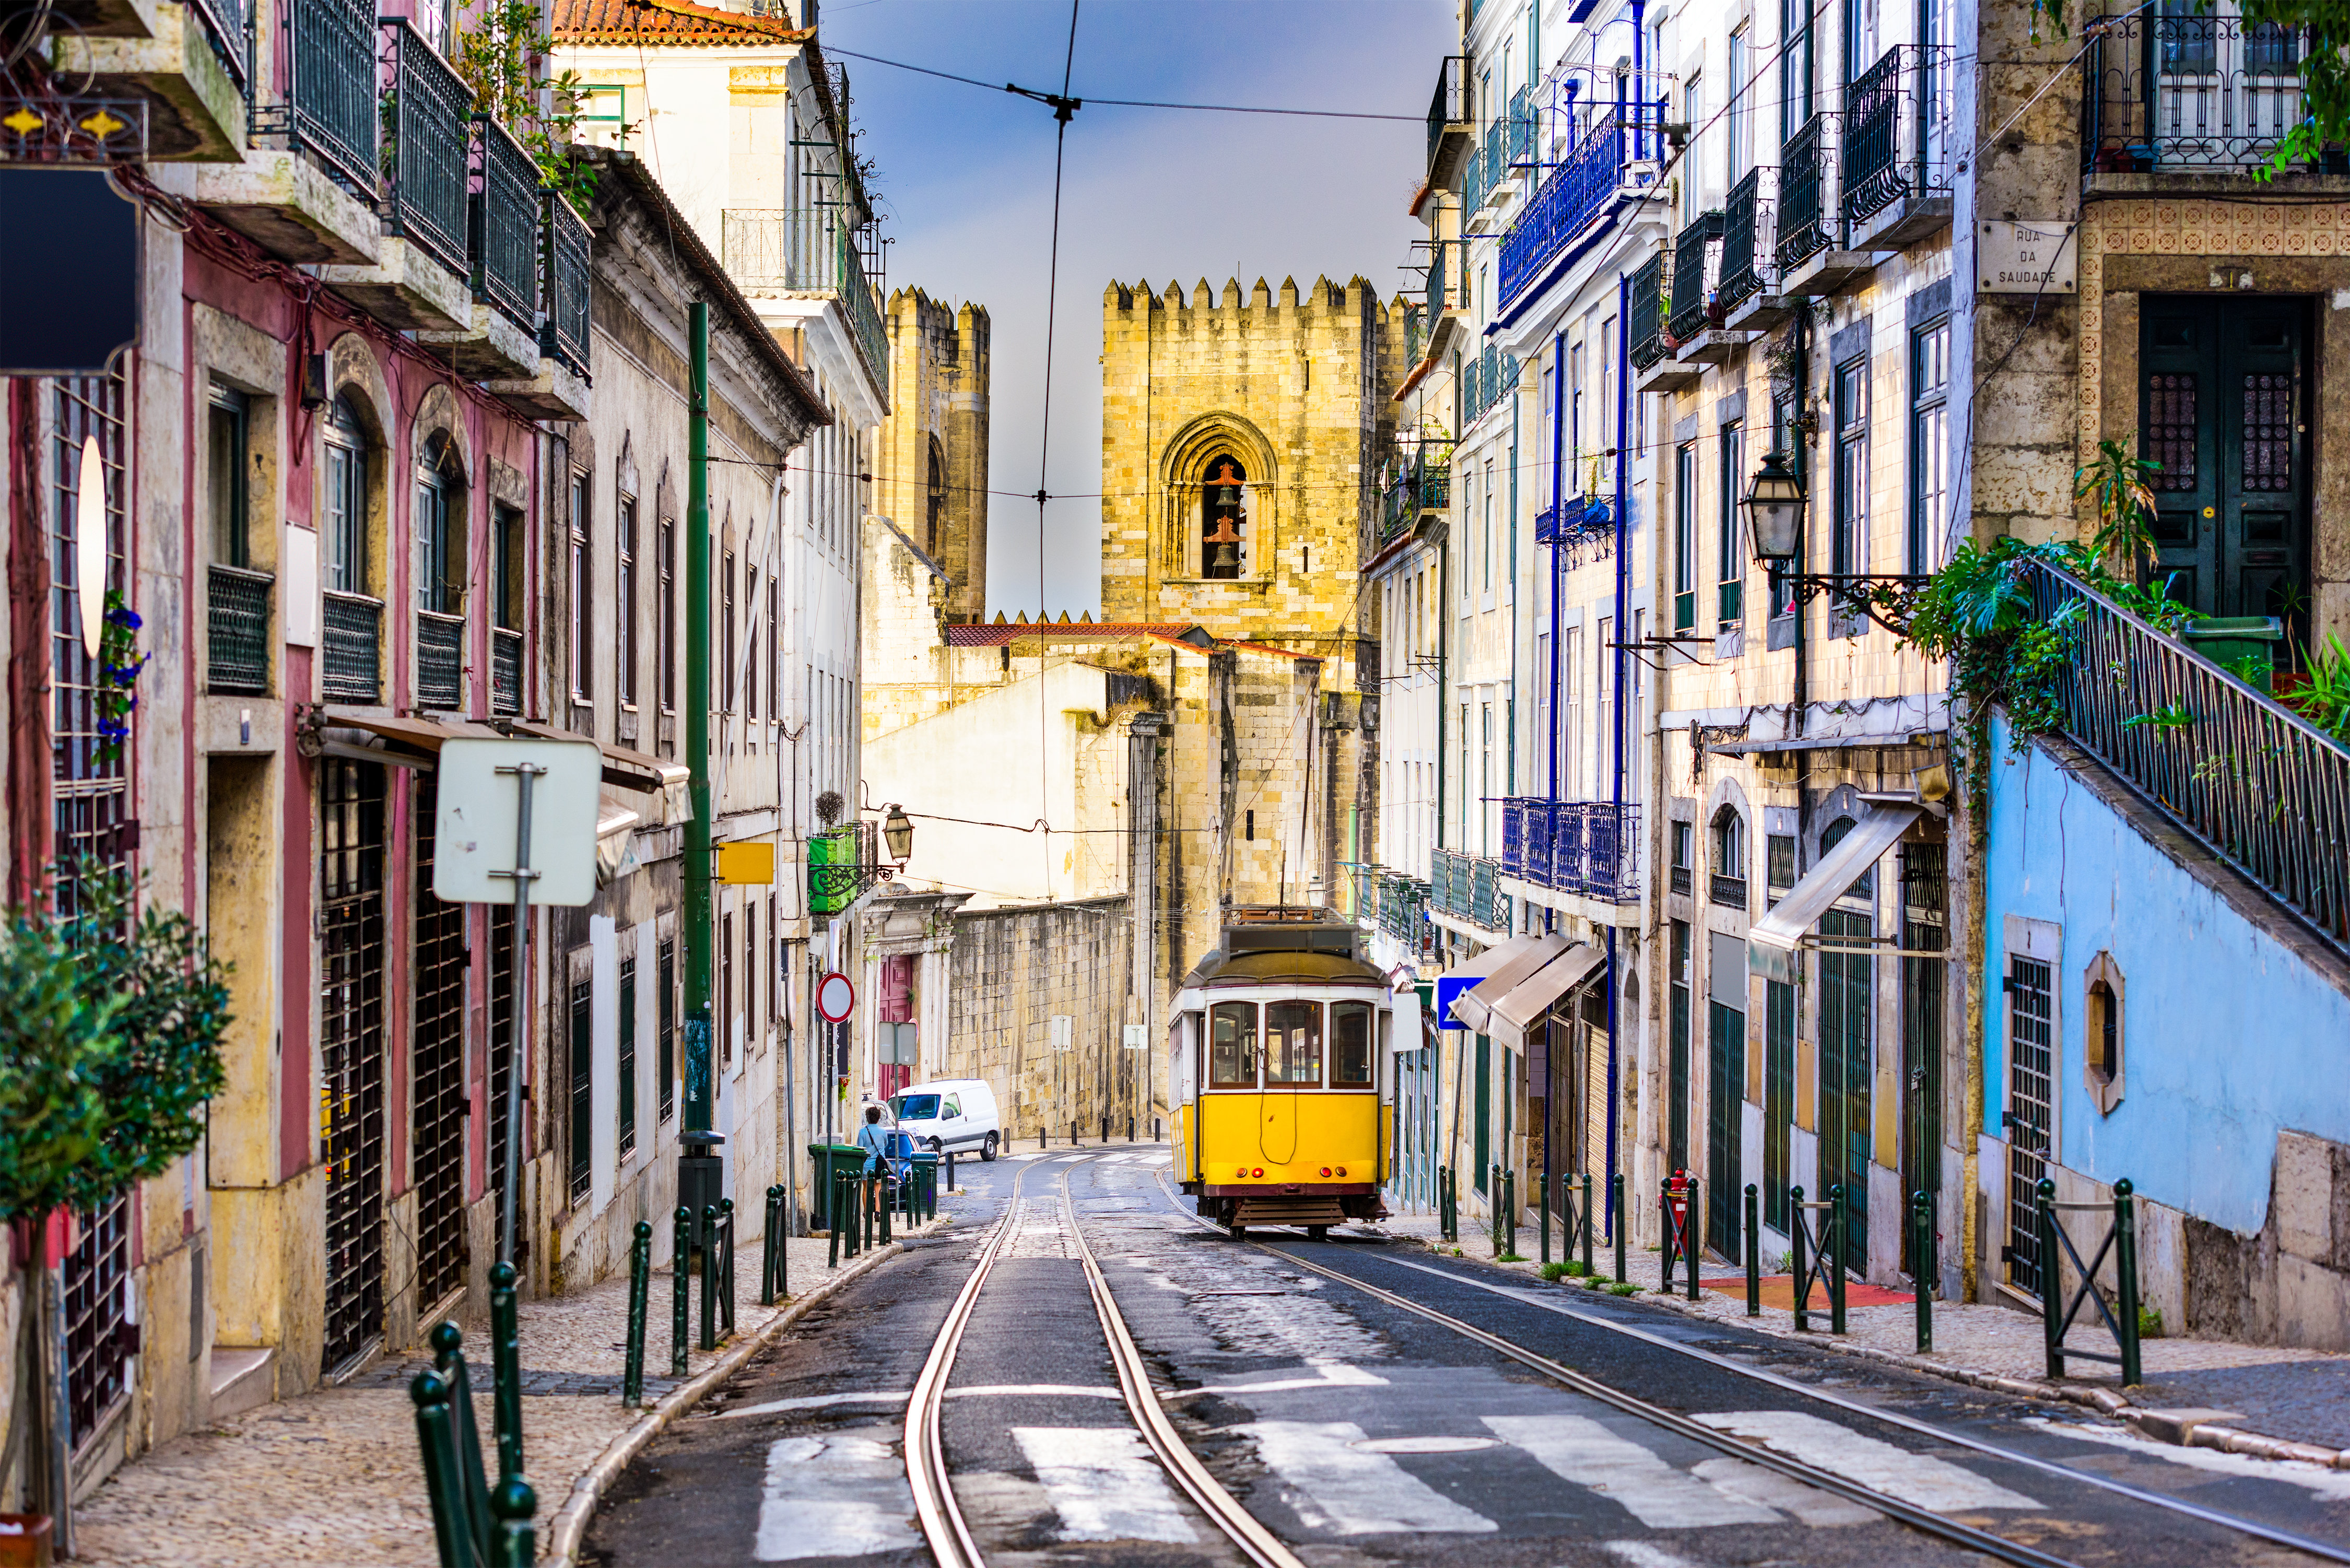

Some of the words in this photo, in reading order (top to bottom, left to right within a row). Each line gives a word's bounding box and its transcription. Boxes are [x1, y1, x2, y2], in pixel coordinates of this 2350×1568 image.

[2017, 231, 2040, 241] RUA
[2020, 251, 2036, 262] DA
[1999, 272, 2055, 282] SAUDADE
